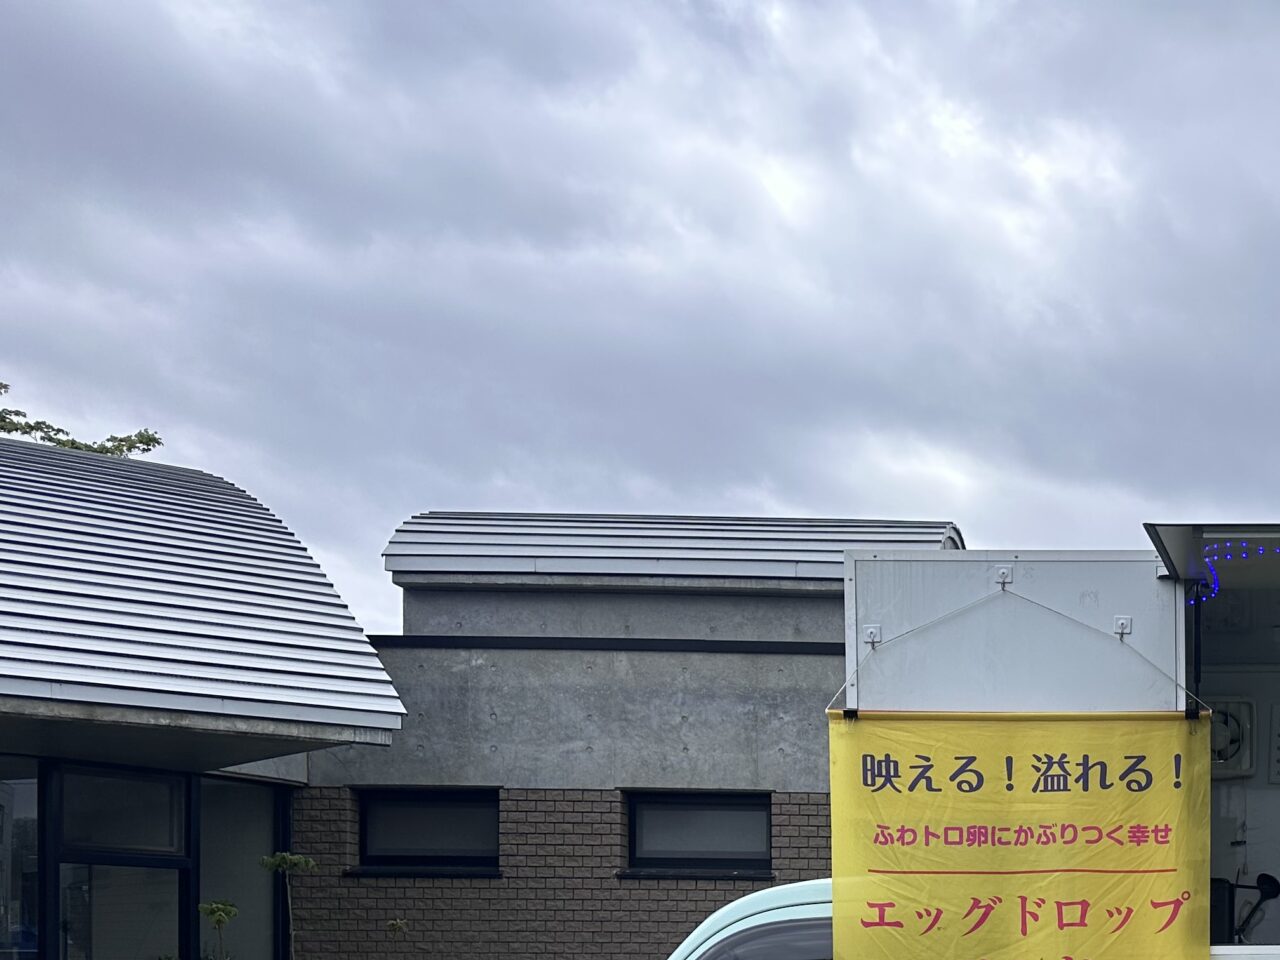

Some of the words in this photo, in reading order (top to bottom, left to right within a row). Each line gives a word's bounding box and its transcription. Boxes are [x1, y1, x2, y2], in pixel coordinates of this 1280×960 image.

[861, 753, 1183, 794] 映える！溢れる！
[873, 823, 1173, 847] ふわトロ卵にかぶりつく幸せ
[861, 891, 1191, 936] エッグドロップ
